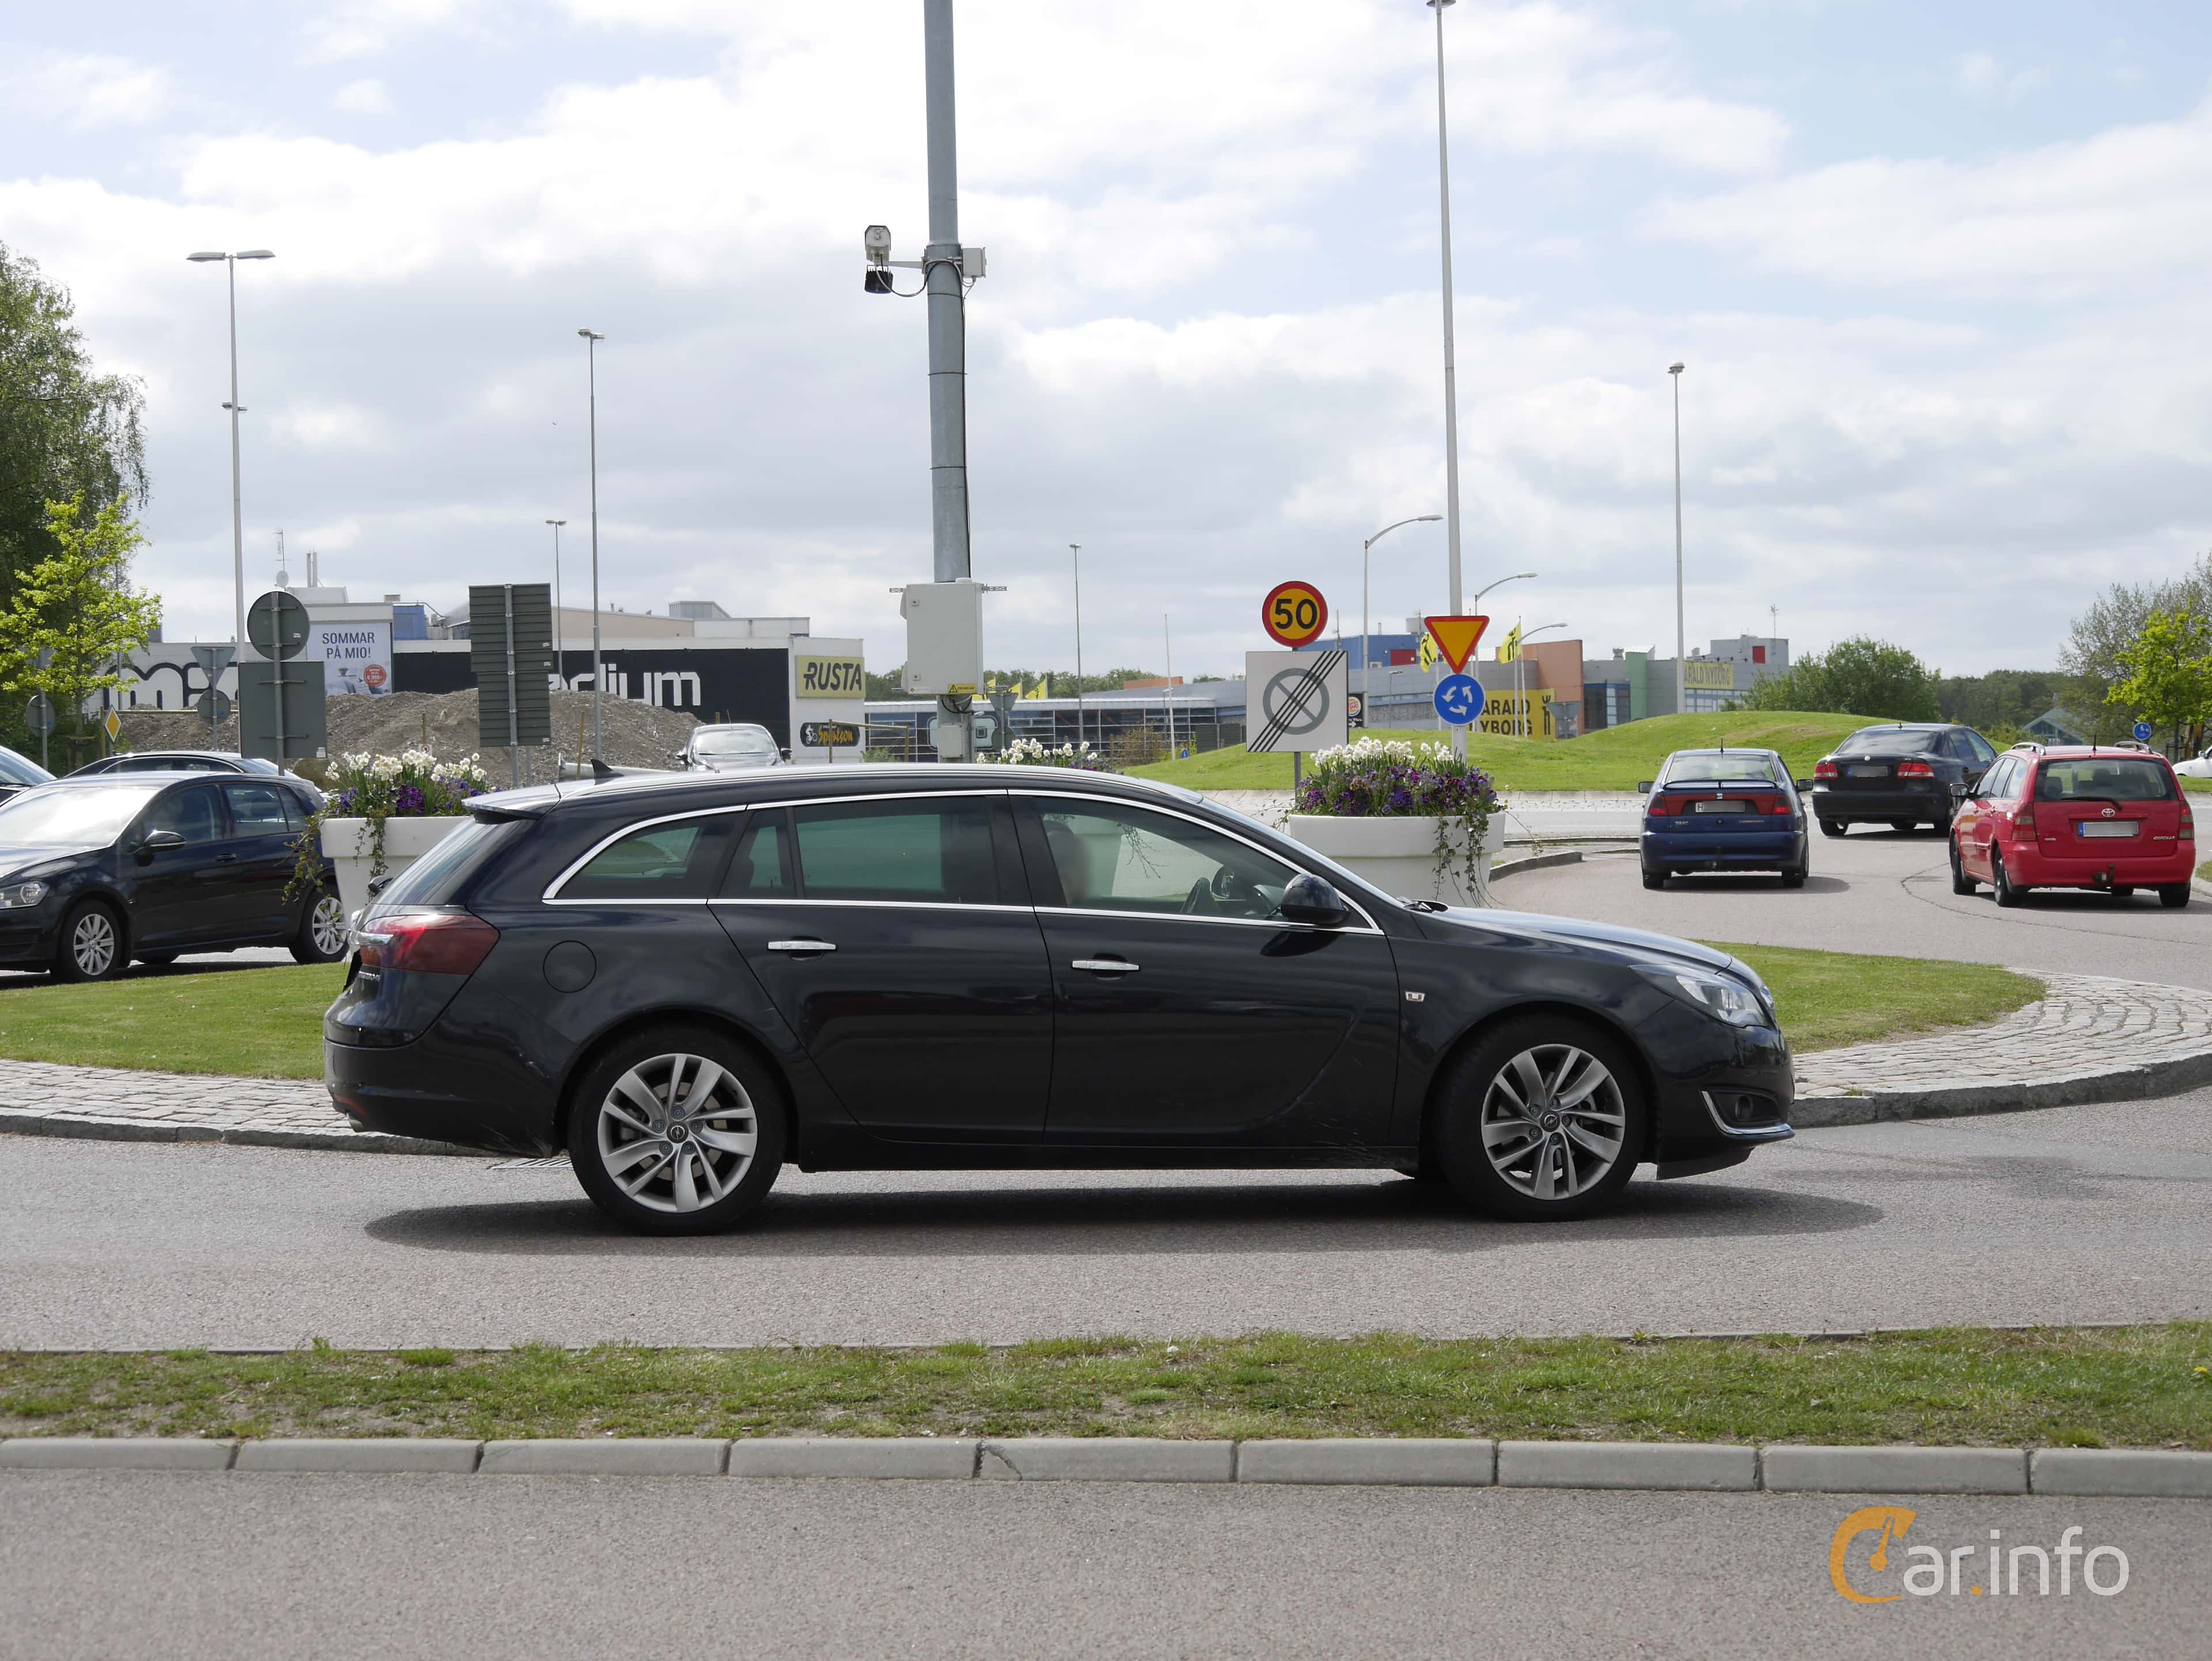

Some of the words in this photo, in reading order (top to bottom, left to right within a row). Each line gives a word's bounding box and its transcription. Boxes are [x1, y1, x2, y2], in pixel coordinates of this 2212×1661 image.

[1274, 599, 1317, 629] 50
[323, 632, 375, 644] SOMMAR
[327, 645, 342, 659] PÅ
[346, 647, 371, 659] MIO!
[804, 662, 862, 691] RUSTA
[1684, 666, 1704, 685] ARALD
[1481, 699, 1531, 715] ARALD
[1469, 720, 1532, 735] YBORG
